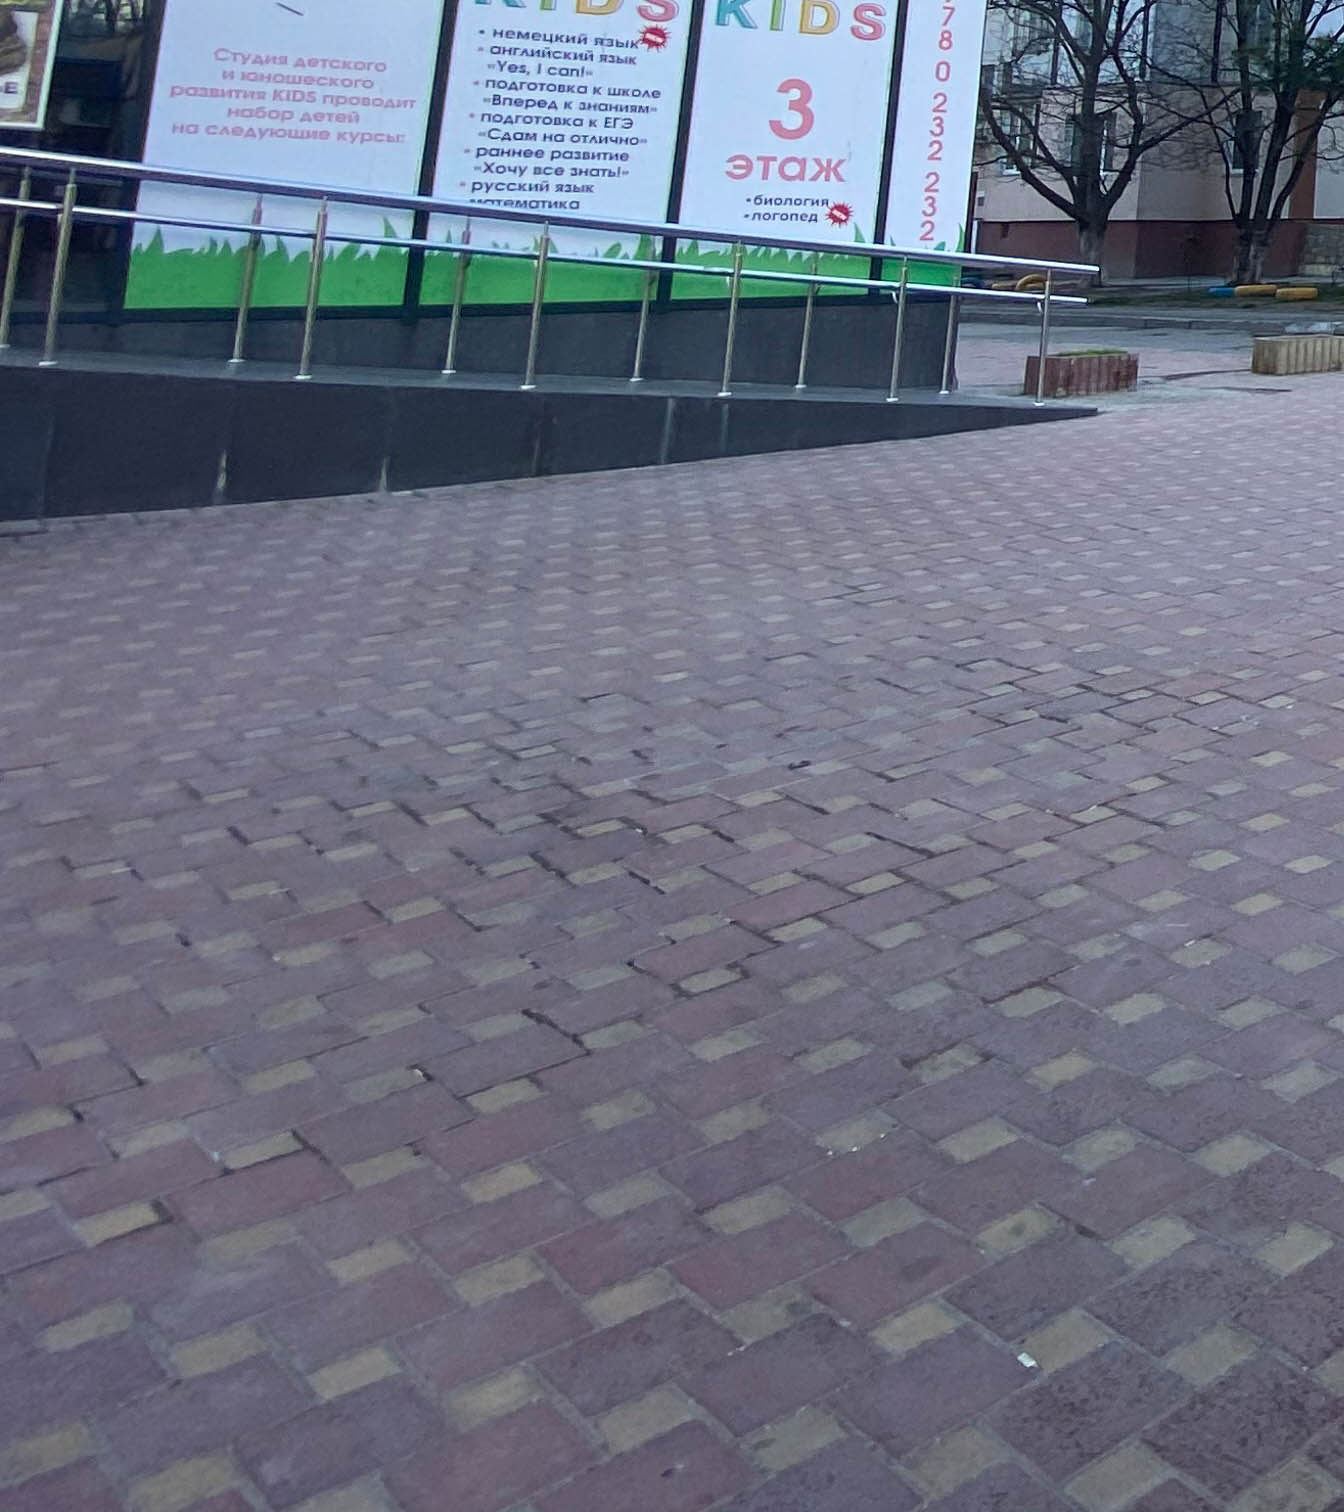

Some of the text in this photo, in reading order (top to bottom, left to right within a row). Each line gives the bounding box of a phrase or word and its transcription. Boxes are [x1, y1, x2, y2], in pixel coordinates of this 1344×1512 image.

[493, 28, 588, 46] немецкий
[594, 37, 639, 50] язык
[213, 47, 388, 73] Студия детского
[490, 45, 637, 65] английский язык
[222, 70, 375, 89] и юношеского
[170, 85, 417, 109] развития KIDS проводит
[485, 79, 662, 100] подготовка к школе
[564, 100, 573, 110] к
[768, 78, 815, 140] 3
[226, 107, 361, 124] набор детей
[481, 113, 634, 129] подготовка к ЕГЭ
[171, 123, 407, 146] на следующие курсы:
[543, 132, 565, 143] на
[475, 146, 630, 161] раннее развитие
[533, 166, 565, 176] все
[725, 154, 847, 183] этаж
[471, 179, 595, 193] русский язык
[753, 194, 830, 207] биология
[751, 211, 818, 223] логопед
